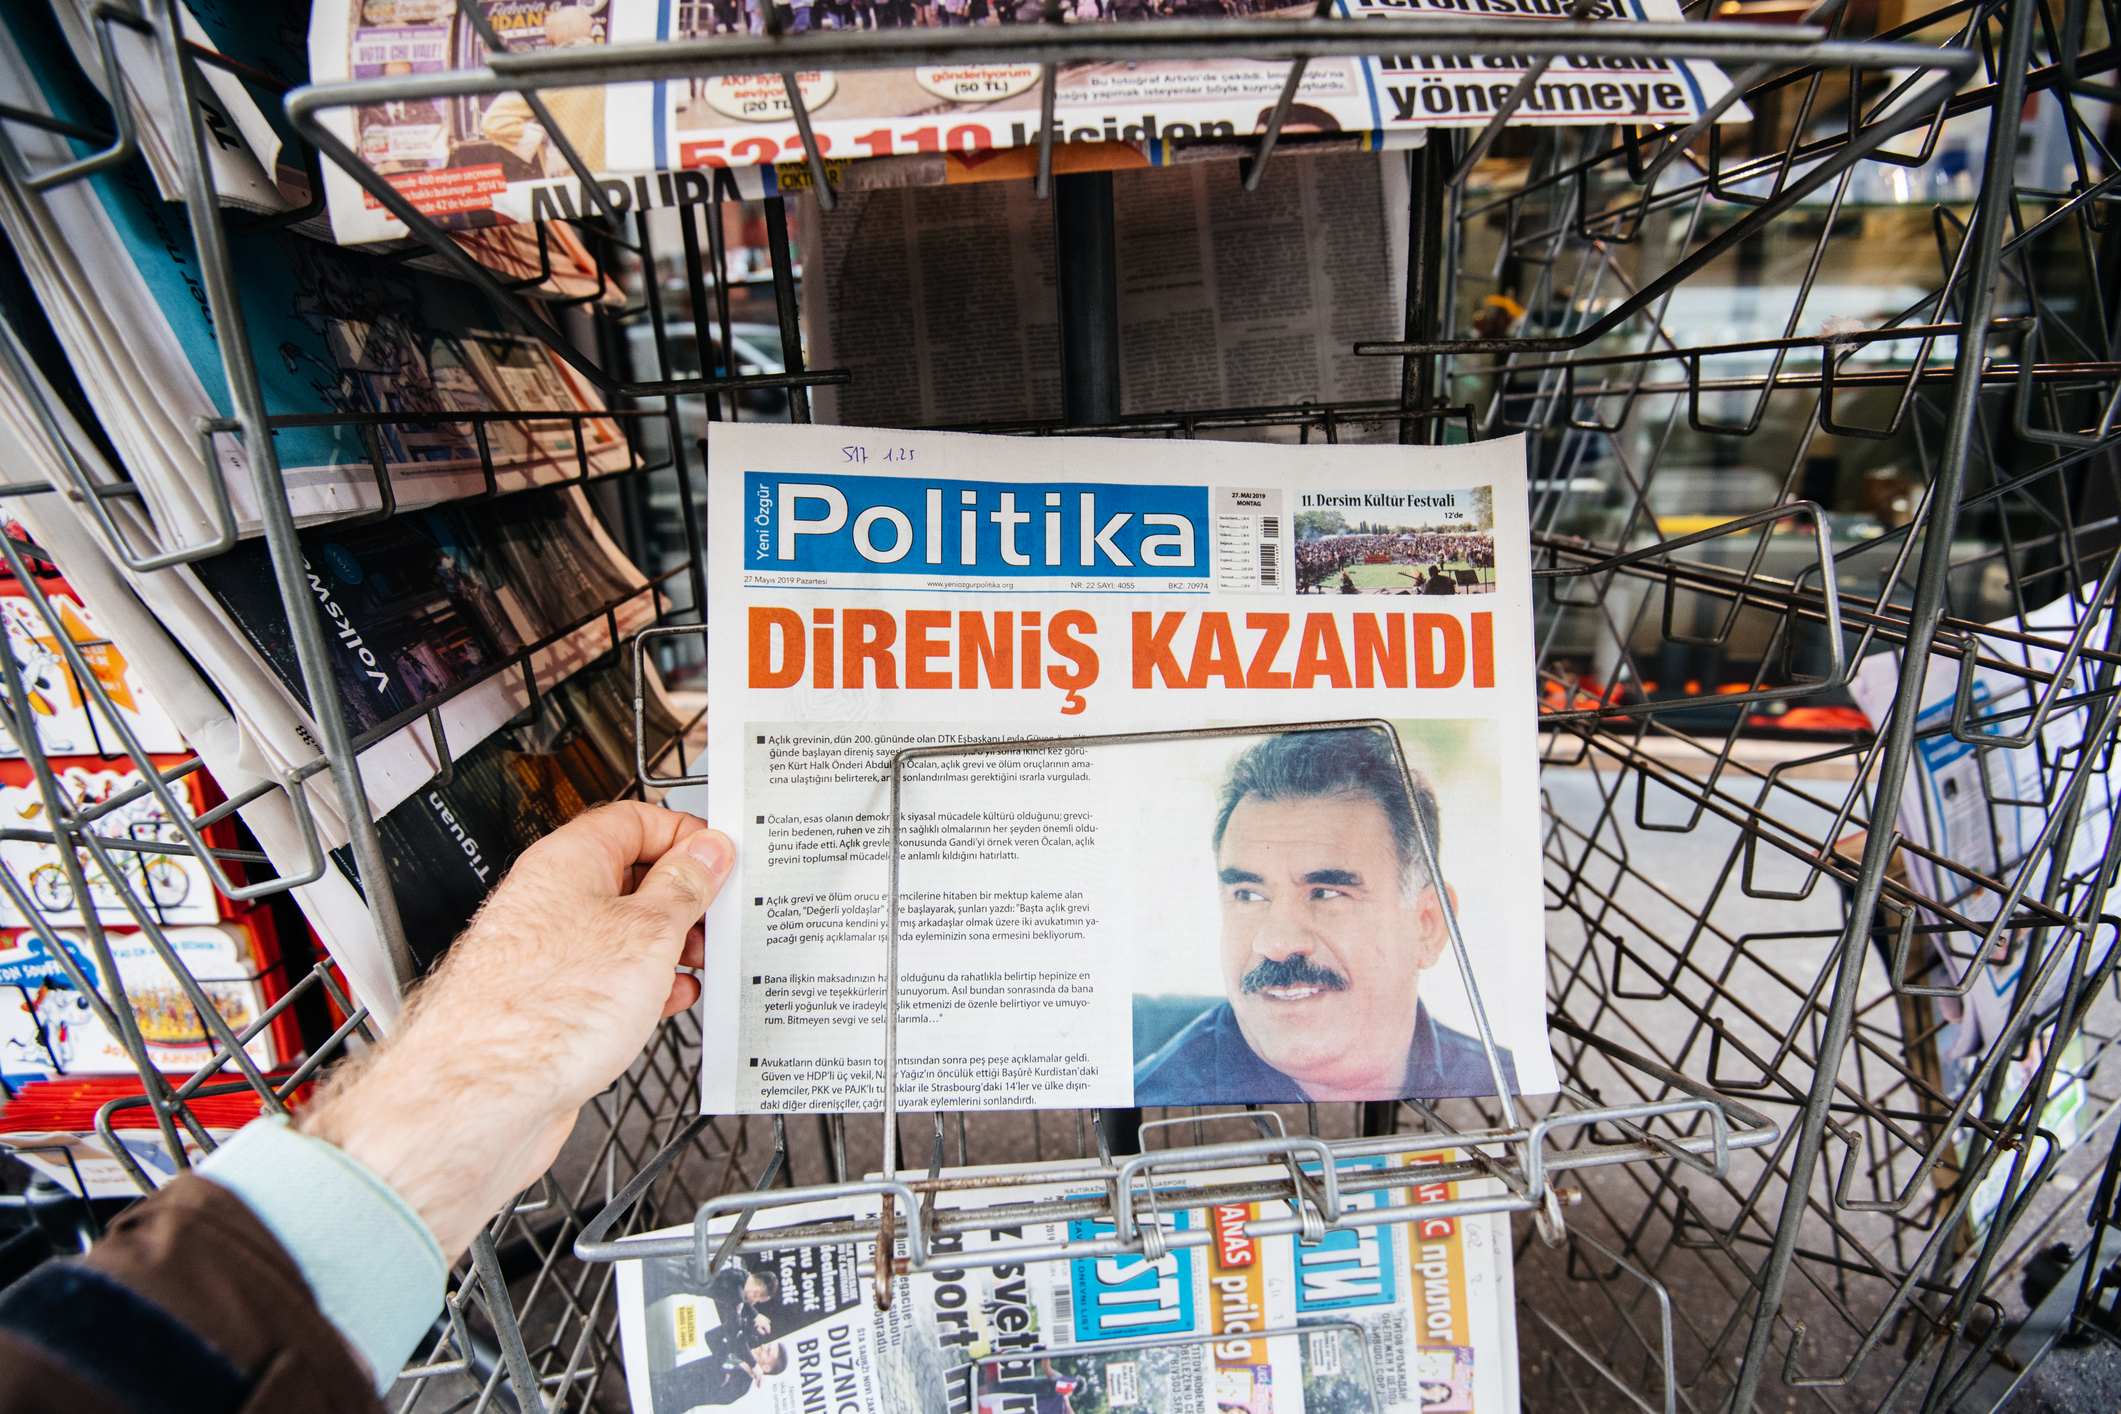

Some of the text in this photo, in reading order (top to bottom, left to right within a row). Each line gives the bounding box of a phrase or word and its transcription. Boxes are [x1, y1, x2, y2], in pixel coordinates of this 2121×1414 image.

[985, 81, 1008, 92] TL)
[772, 101, 794, 112] TL
[1301, 494, 1456, 507] 11. Dersim Kültür Festvali
[754, 483, 773, 560] Yeni Özgür
[777, 482, 1196, 568] Politika
[754, 576, 776, 585] Mayıs
[778, 576, 794, 584] 2019
[926, 580, 1014, 590] www.yeniozgurpolitika.org
[1097, 582, 1116, 590] SAYI:
[1117, 582, 1136, 590] 4055
[1168, 582, 1186, 590] BKZ:
[1132, 611, 1495, 690] KAZANDI
[768, 735, 791, 747] Açlık
[792, 735, 833, 747] grevinin,
[833, 734, 852, 744] dün
[854, 734, 873, 744] 200.
[873, 734, 916, 746] gününde
[916, 734, 936, 744] olan
[937, 734, 957, 743] DTK
[957, 734, 1003, 748] Eşbaşkanı
[769, 745, 872, 760] ğünde başlayan direniş
[769, 759, 863, 773] şen Kürt Halk Önderi
[905, 757, 940, 770] Öcalan,
[940, 759, 961, 771] açlık
[961, 760, 985, 771] grevi
[985, 761, 997, 769] ve
[998, 759, 1022, 769] ölüm
[1022, 759, 1070, 770] oruçlarının
[769, 773, 880, 786] cına ulaştığını belirterek,
[902, 772, 1091, 784] sonlandırılması gerektiğini ısrarla vurguladı.
[907, 811, 1093, 823] siyasal mücadele kültürü olduğunu; grevci-
[909, 821, 1099, 836] sağlıklı olmalarının her şeyden önemli oldu-
[429, 792, 490, 884] Tiguan
[942, 890, 1083, 902] hitaben bir mektup kaleme alan
[900, 971, 1091, 985] olduğunu da rahatlıkla belirtip hepinize en
[936, 1068, 974, 1079] öncülük
[975, 1068, 1000, 1080] ettiği
[918, 1083, 929, 1093] ile
[1031, 1083, 1043, 1091] ve
[1044, 1080, 1064, 1091] ülke
[1065, 1080, 1091, 1092] dışın-
[1046, 1225, 1055, 1240] 2019
[1219, 1203, 1252, 1264] ANAS
[780, 1256, 798, 1305] Kostić
[1078, 1266, 1088, 1306] DNEVNI
[801, 1272, 820, 1312] Jović
[1413, 1245, 1453, 1341] прилог
[1080, 1308, 1089, 1331] LIST
[1382, 1313, 1394, 1364] ОБЕЛЕЖЕН
[1394, 1318, 1403, 1346] ТИТОВ
[1372, 1326, 1382, 1365] БИВШОЈ
